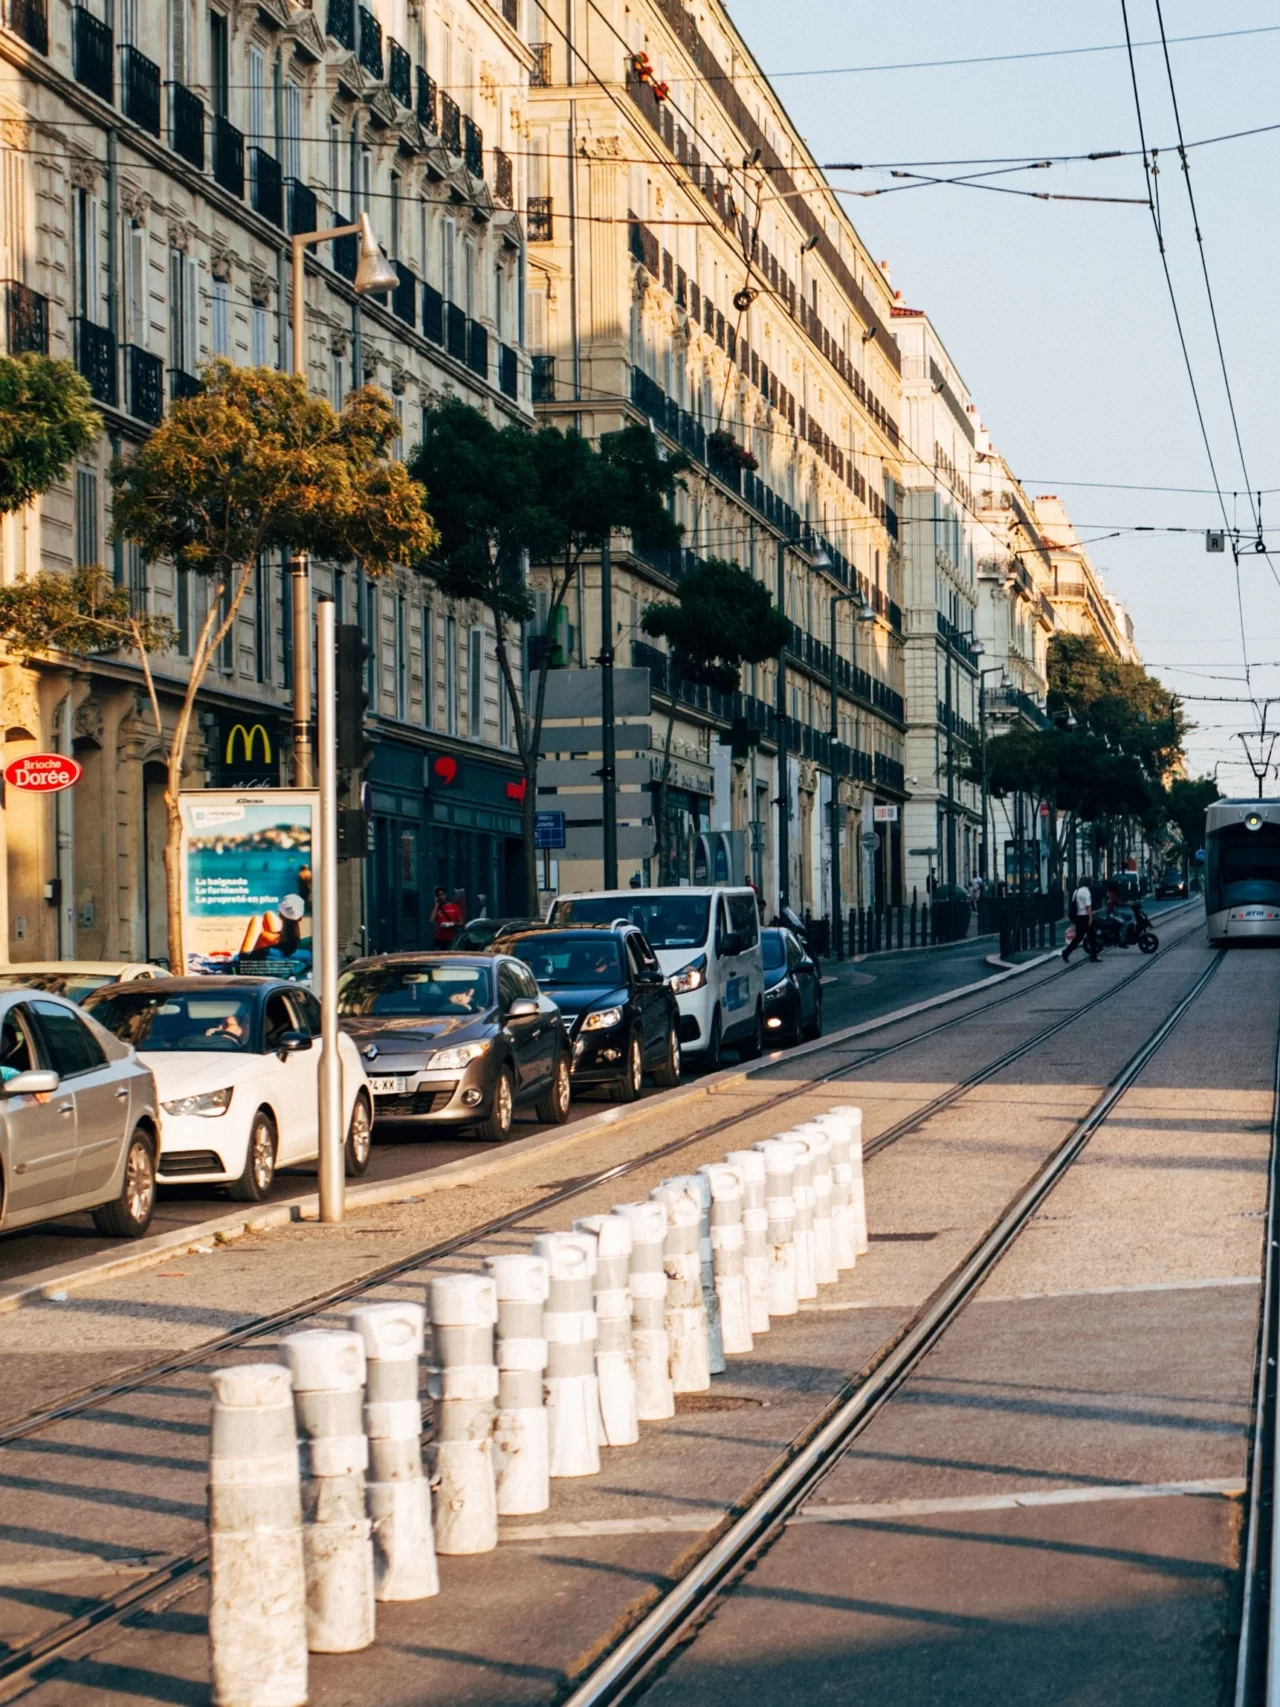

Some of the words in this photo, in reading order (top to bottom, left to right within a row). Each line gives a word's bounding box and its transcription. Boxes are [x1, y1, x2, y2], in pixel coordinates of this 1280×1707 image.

[23, 759, 62, 769] Brioche
[15, 769, 70, 786] Dorée
[259, 895, 279, 905] plus
